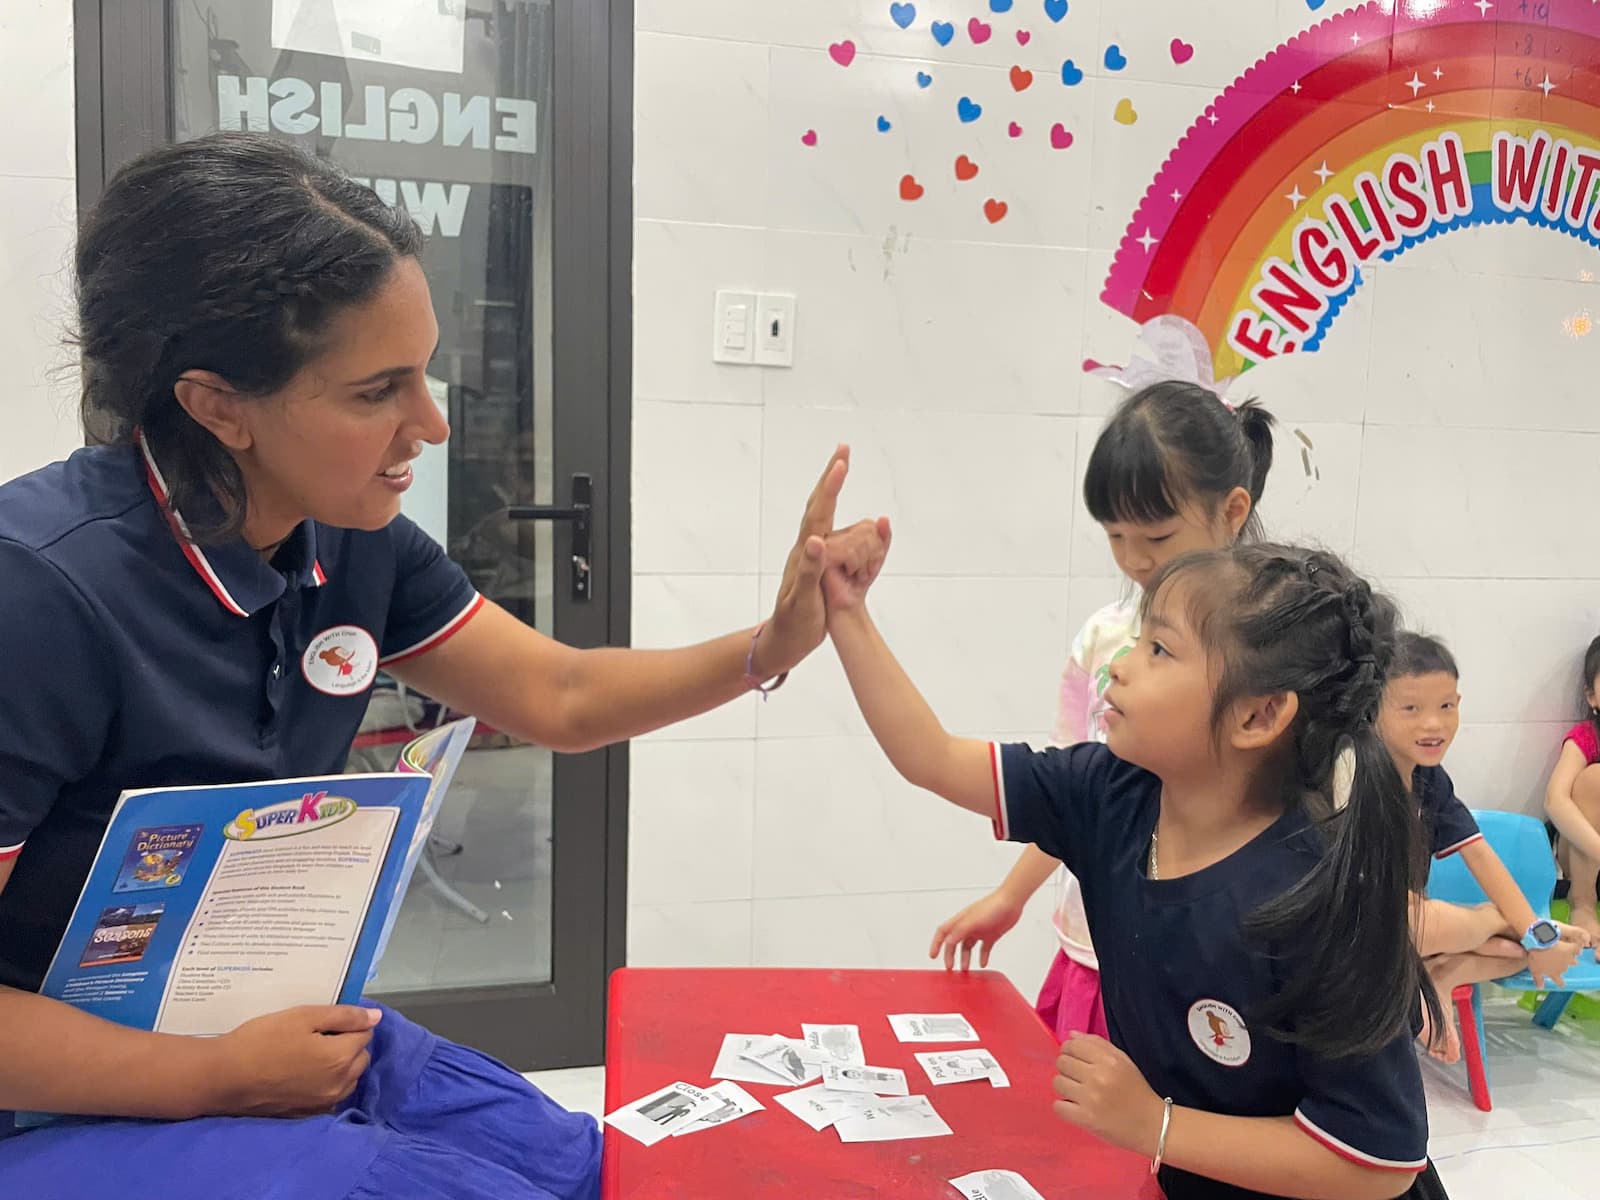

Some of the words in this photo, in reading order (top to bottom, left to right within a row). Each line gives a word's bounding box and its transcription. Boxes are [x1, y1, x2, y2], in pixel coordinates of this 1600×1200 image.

[1234, 138, 1467, 359] ENGLISH
[1498, 137, 1600, 231] WIT
[137, 839, 194, 852] Dictionary
[150, 832, 189, 843] Picture
[94, 927, 154, 944] Seasons
[674, 1083, 710, 1102] Close
